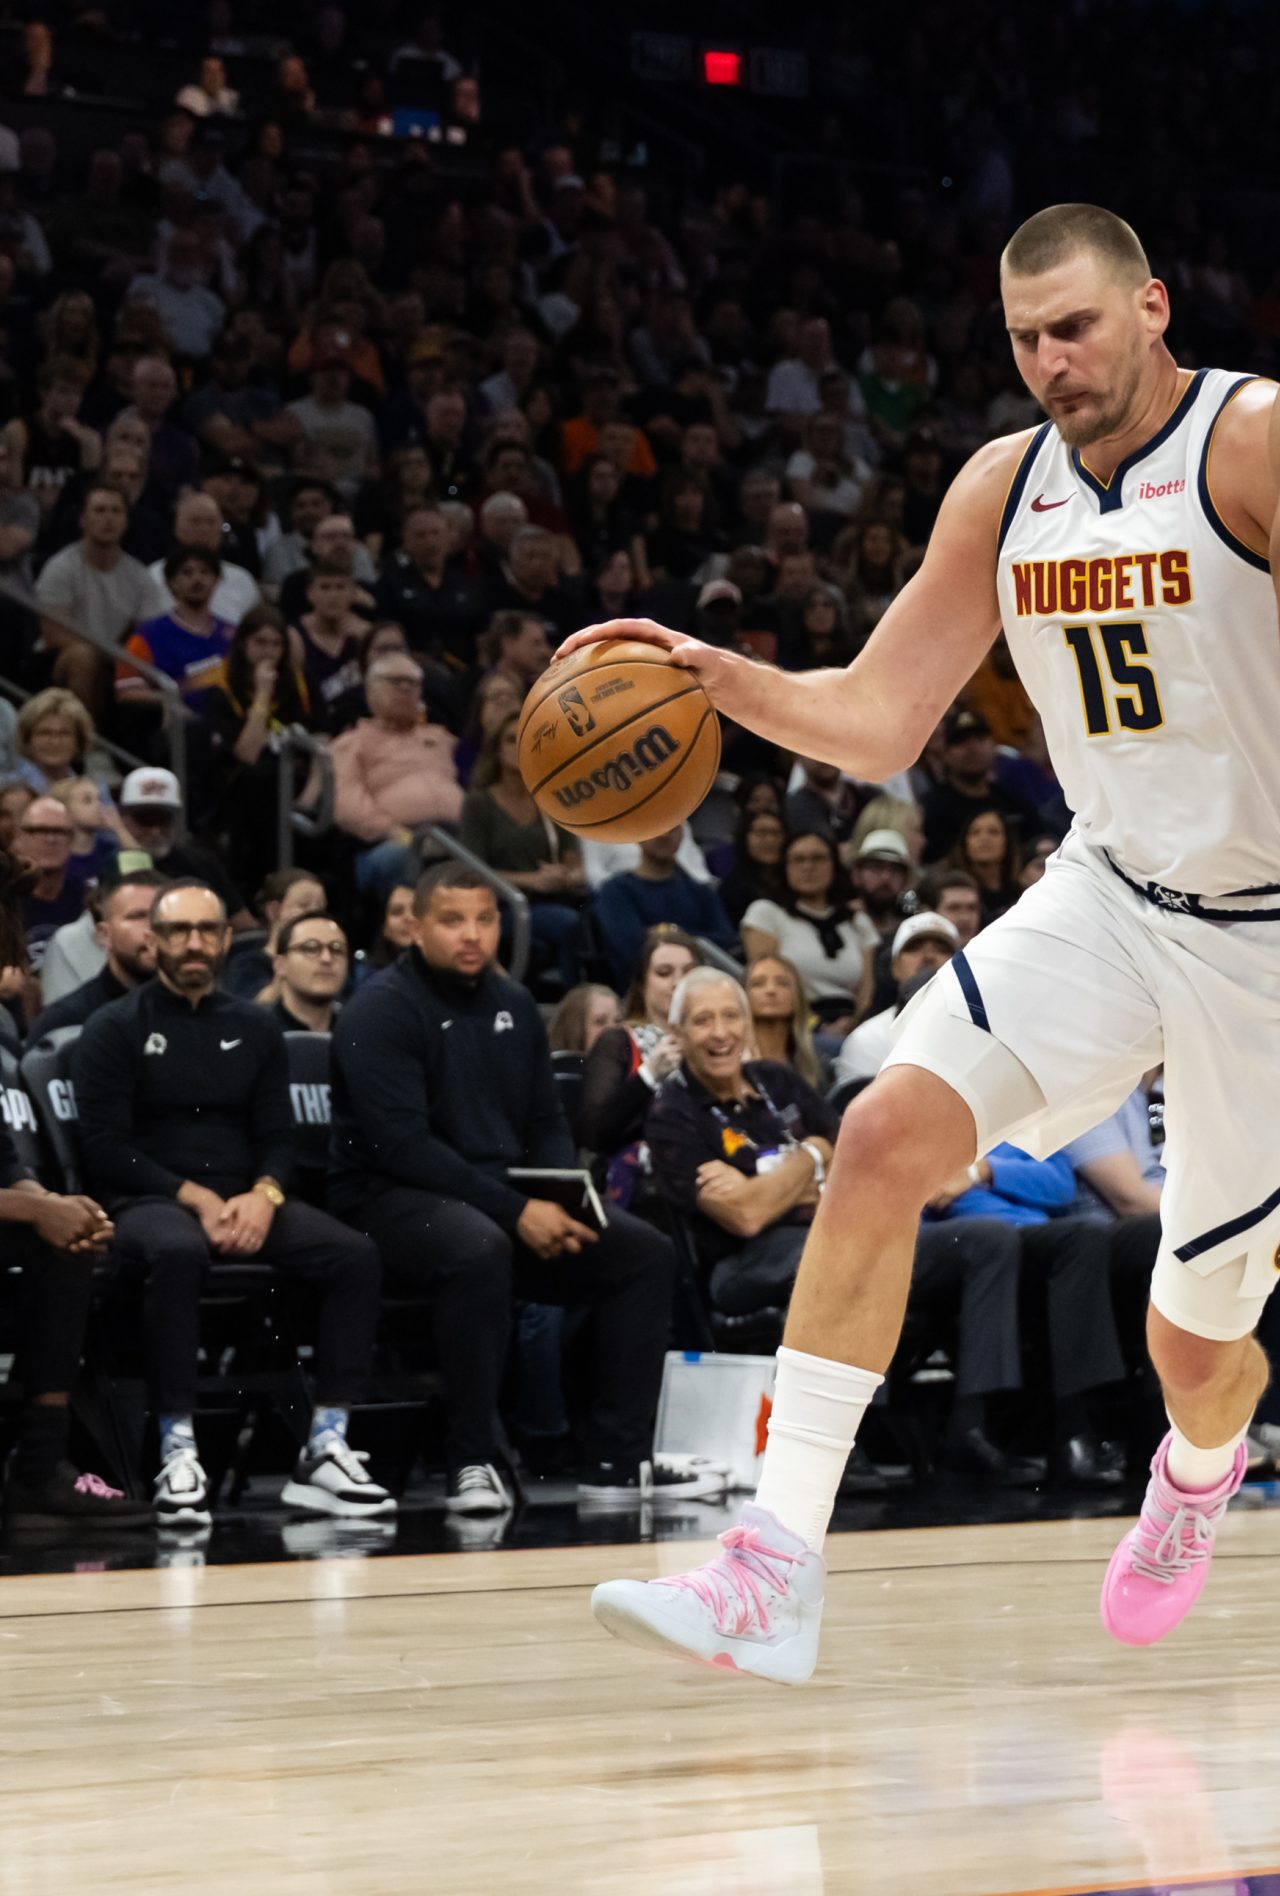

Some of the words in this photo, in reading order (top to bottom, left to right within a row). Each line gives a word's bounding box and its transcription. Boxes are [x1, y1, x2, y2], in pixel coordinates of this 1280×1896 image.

[1011, 549, 1194, 617] NUGGETS
[1062, 620, 1167, 738] 15
[551, 724, 681, 811] Wilson
